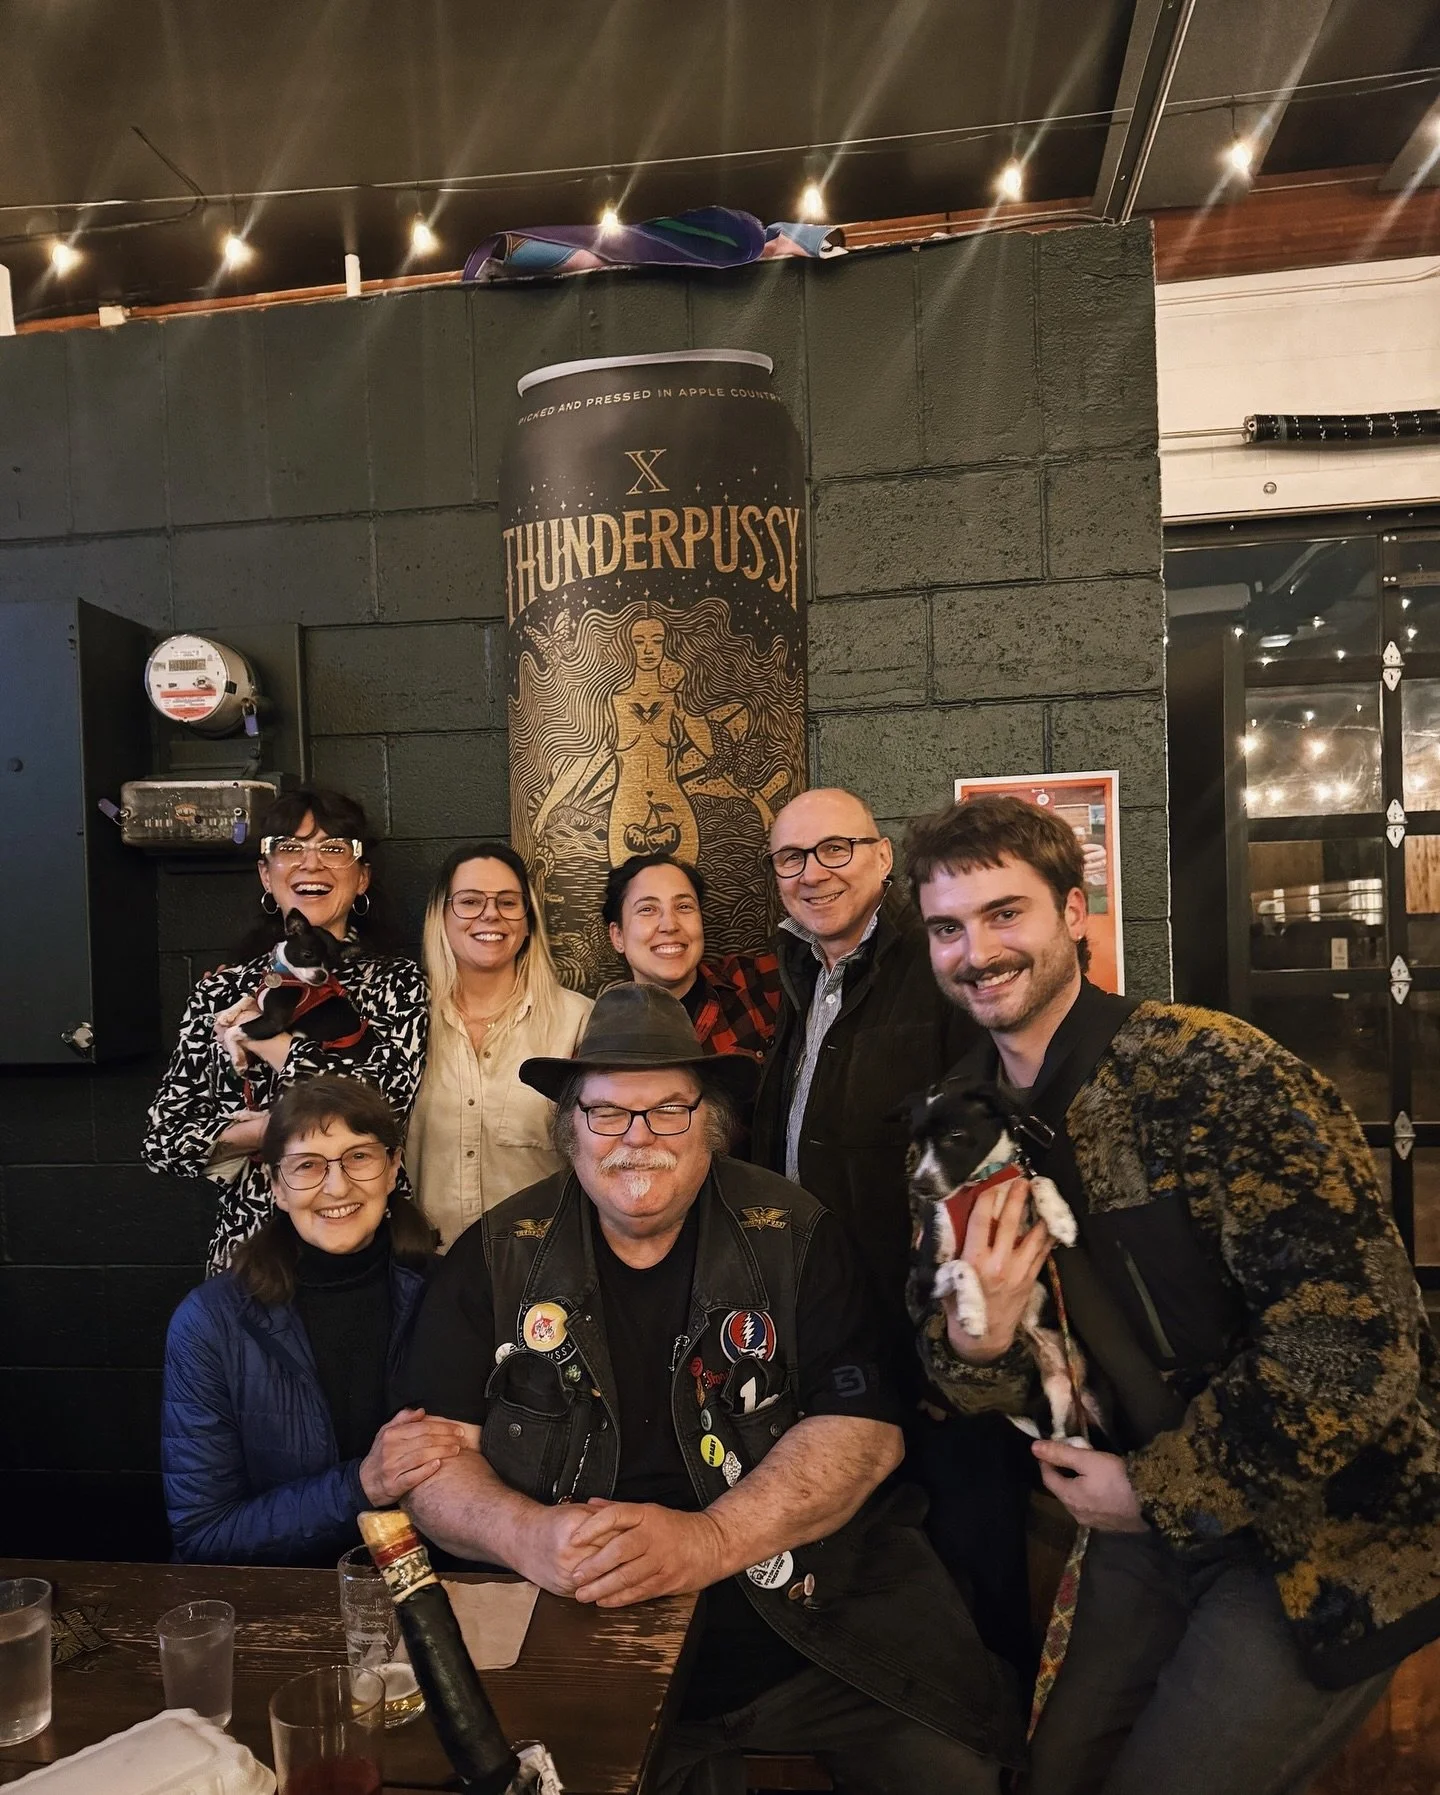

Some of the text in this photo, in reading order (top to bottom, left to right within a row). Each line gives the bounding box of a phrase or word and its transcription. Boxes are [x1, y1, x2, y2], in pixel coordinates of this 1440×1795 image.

[518, 406, 555, 426] PICKED
[558, 400, 582, 415] AND
[586, 389, 651, 408] PRESSED
[658, 388, 672, 398] IN
[679, 387, 725, 399] APPLE
[624, 448, 671, 496] X
[502, 504, 801, 632] THUNDERPUSSY
